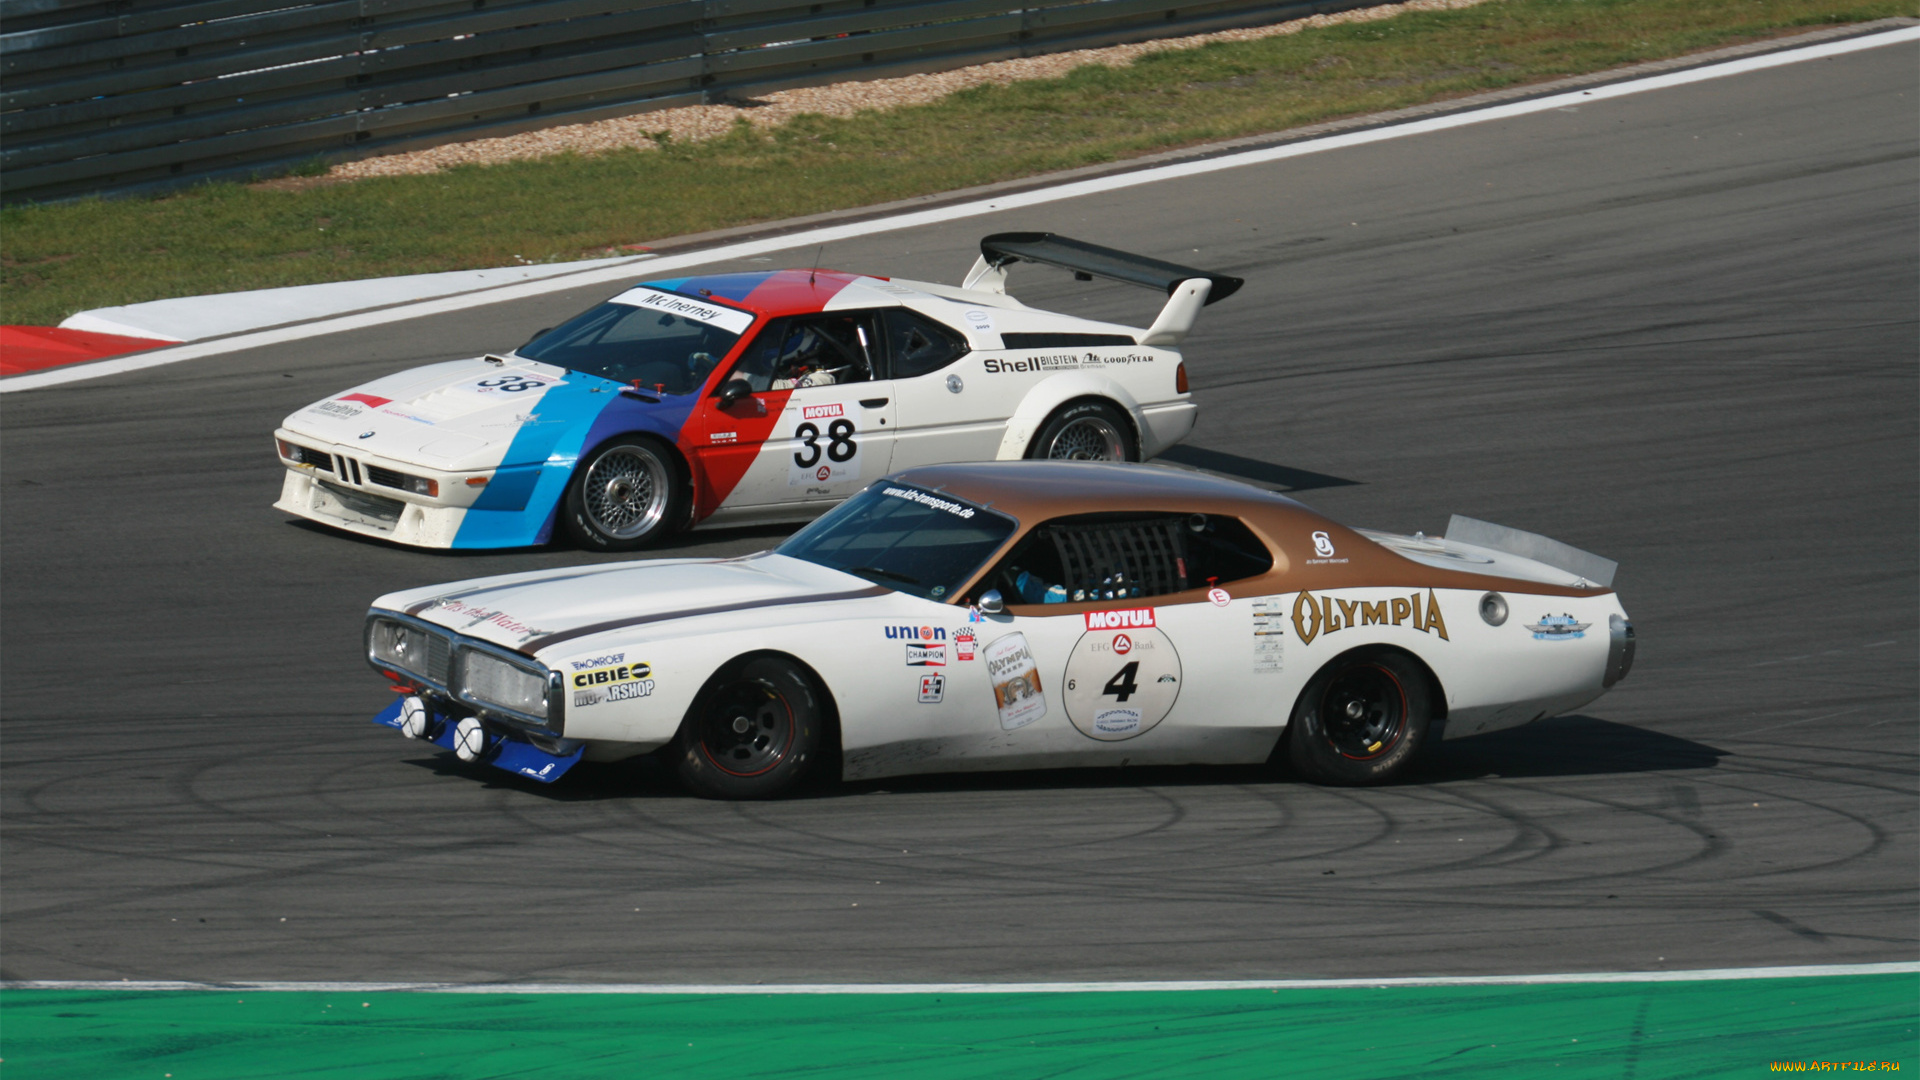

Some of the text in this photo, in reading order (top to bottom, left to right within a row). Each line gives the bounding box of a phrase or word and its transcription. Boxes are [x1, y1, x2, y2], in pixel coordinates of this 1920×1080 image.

[642, 294, 722, 320] Mc Inerney
[984, 357, 1041, 373] Shell
[1041, 355, 1078, 365] BILSTEIN
[477, 375, 546, 392] 38
[805, 405, 843, 419] MOTUL
[794, 418, 857, 468] 38
[1088, 609, 1154, 628] MOTUL
[1291, 587, 1450, 646] OLYMPIA
[884, 625, 947, 640] union
[1091, 640, 1155, 652] EFG Bank
[579, 654, 621, 669] MONROE
[908, 650, 944, 659] CHAMPION
[574, 666, 630, 687] CIBIE
[1068, 679, 1076, 690] 6
[1102, 660, 1140, 702] 4
